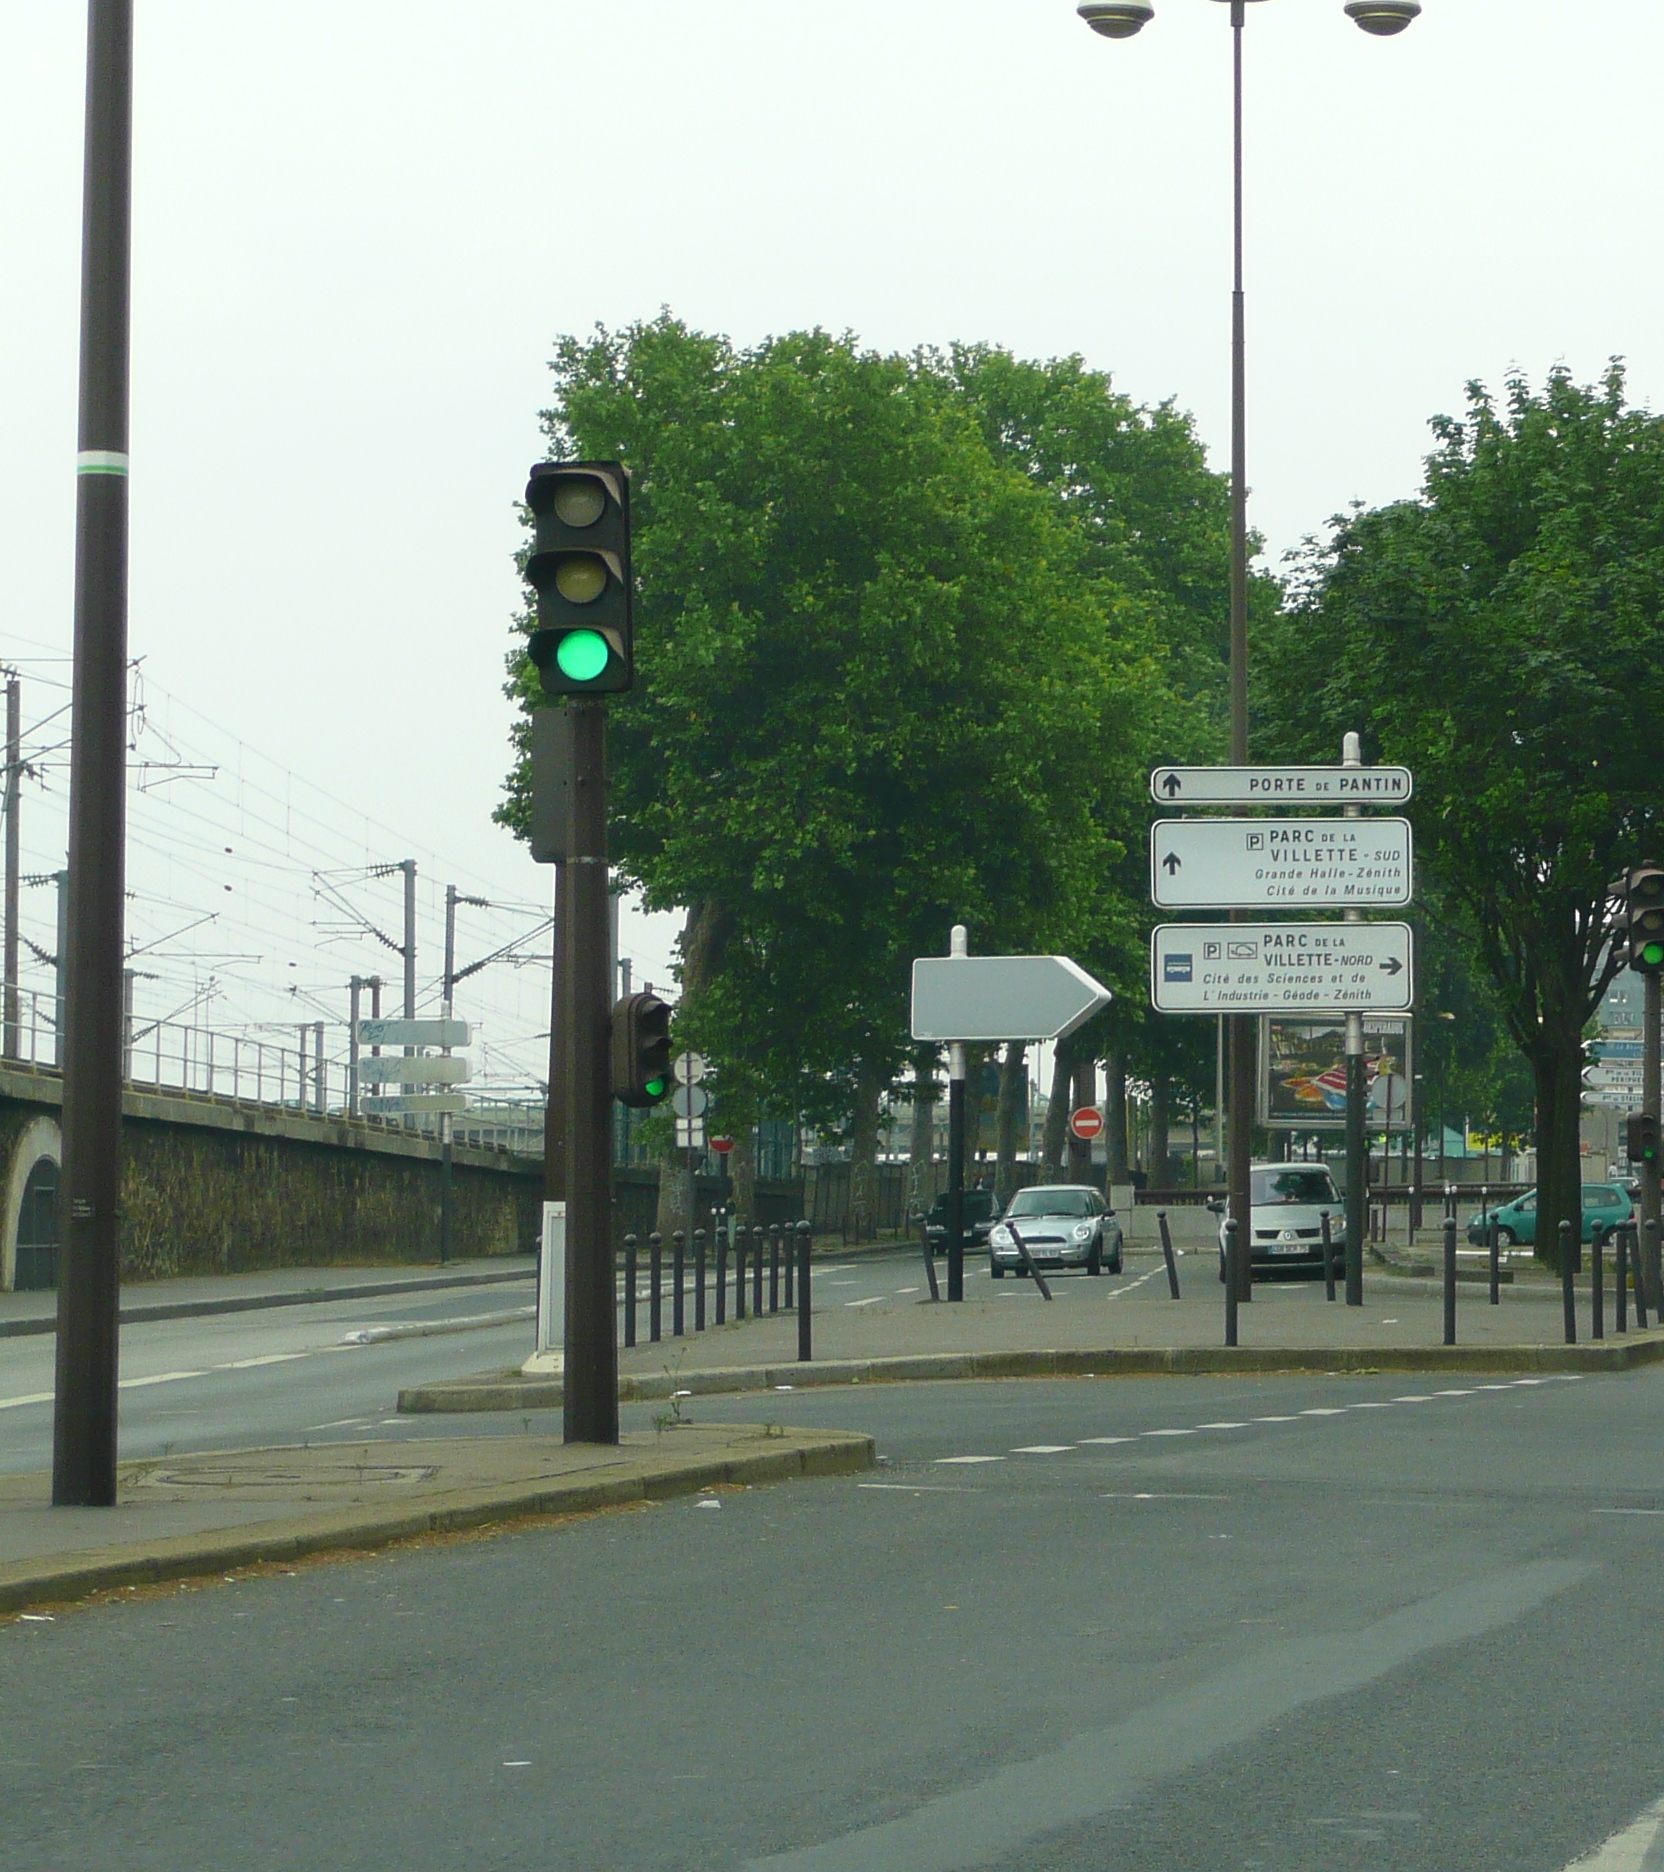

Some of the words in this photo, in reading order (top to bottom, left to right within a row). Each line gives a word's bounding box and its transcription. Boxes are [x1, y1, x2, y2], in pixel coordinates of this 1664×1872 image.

[1250, 778, 1306, 792] PORTE
[1315, 782, 1330, 791] DE
[1339, 778, 1401, 791] PANTIN
[1270, 830, 1315, 843] PARC
[1321, 833, 1335, 842] DE
[1343, 833, 1356, 842] LA
[1271, 849, 1358, 862] VILLETTE
[1374, 850, 1401, 861] SUD
[1255, 868, 1303, 879] Grande
[1266, 885, 1295, 896] Cité
[1302, 885, 1317, 896] de
[1325, 885, 1337, 895] la
[1344, 884, 1401, 897] Musique
[1263, 934, 1308, 948] PARC
[1315, 938, 1328, 947] DE
[1333, 938, 1346, 946] LA
[1203, 973, 1230, 984] Cité
[1238, 973, 1259, 984] des
[1267, 973, 1323, 983] Sciences
[1331, 973, 1343, 983] et
[1351, 972, 1366, 983] de
